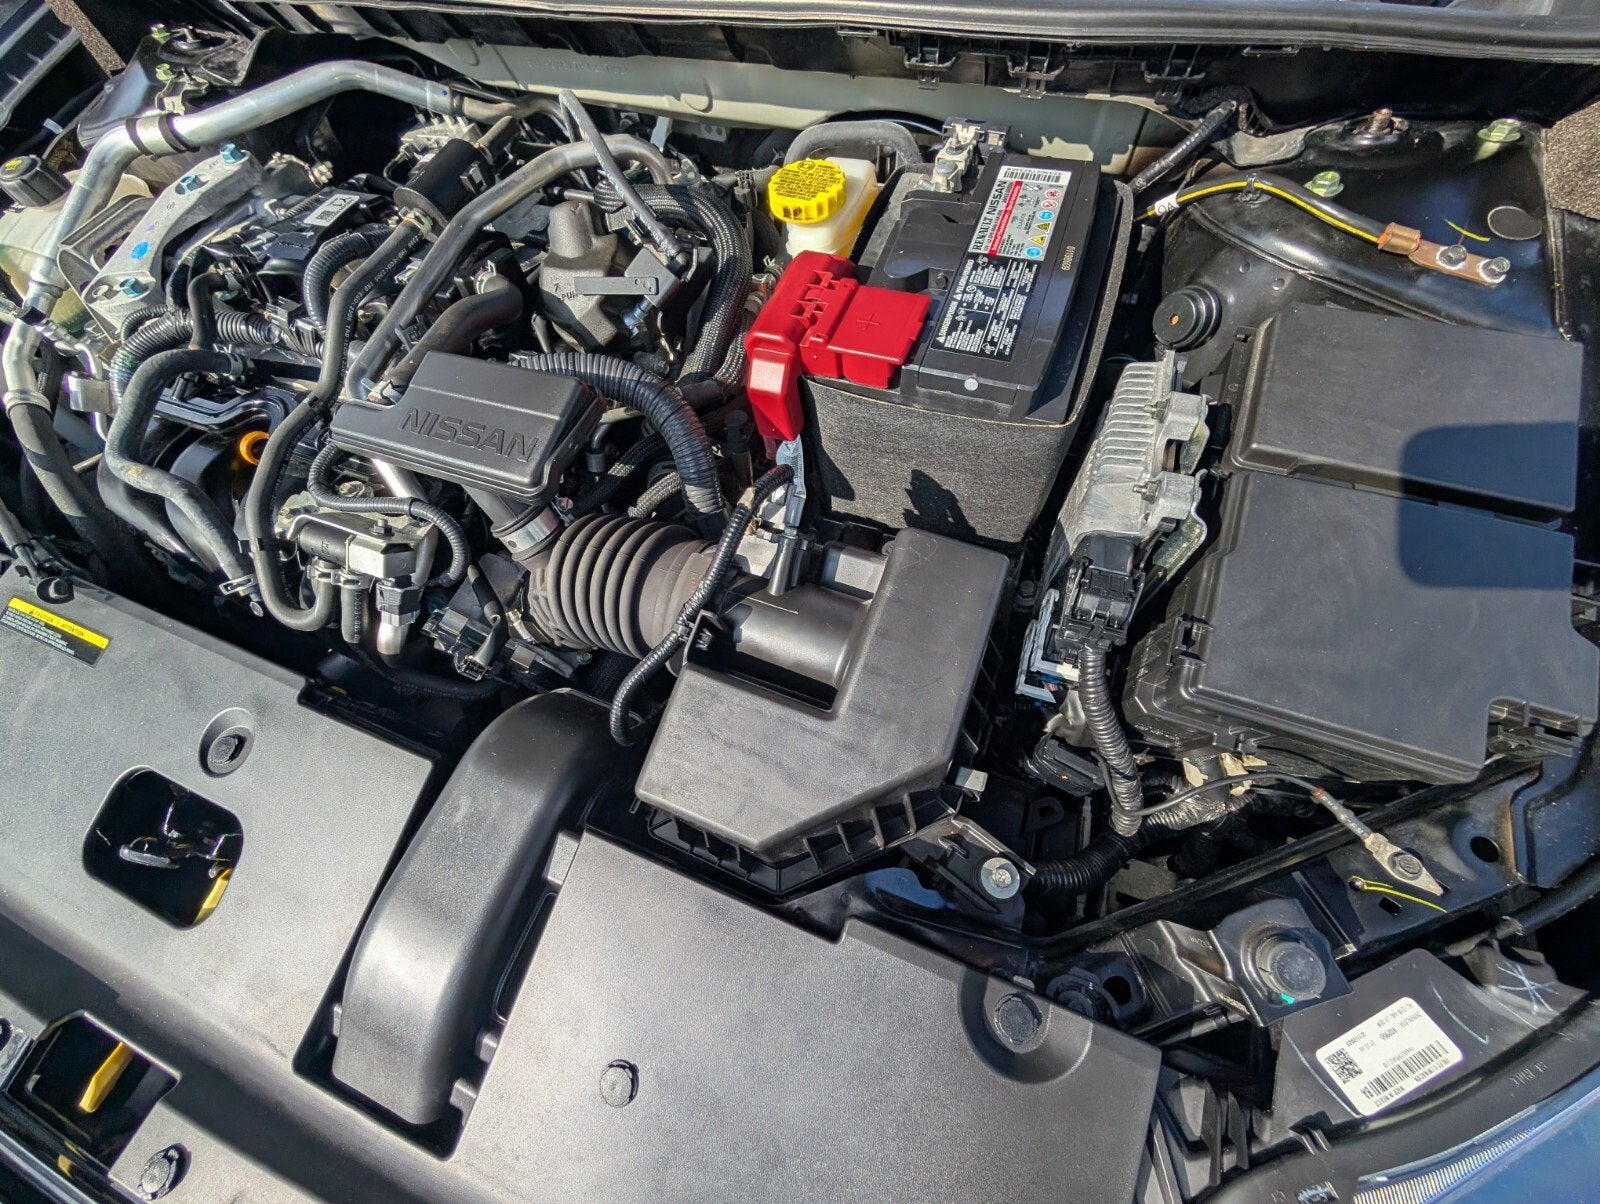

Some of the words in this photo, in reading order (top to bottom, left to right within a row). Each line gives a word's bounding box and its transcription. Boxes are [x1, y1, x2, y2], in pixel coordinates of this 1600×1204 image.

[971, 215, 994, 250] RENAULT
[985, 180, 1007, 215] NISSAN
[400, 408, 539, 462] NISSAN
